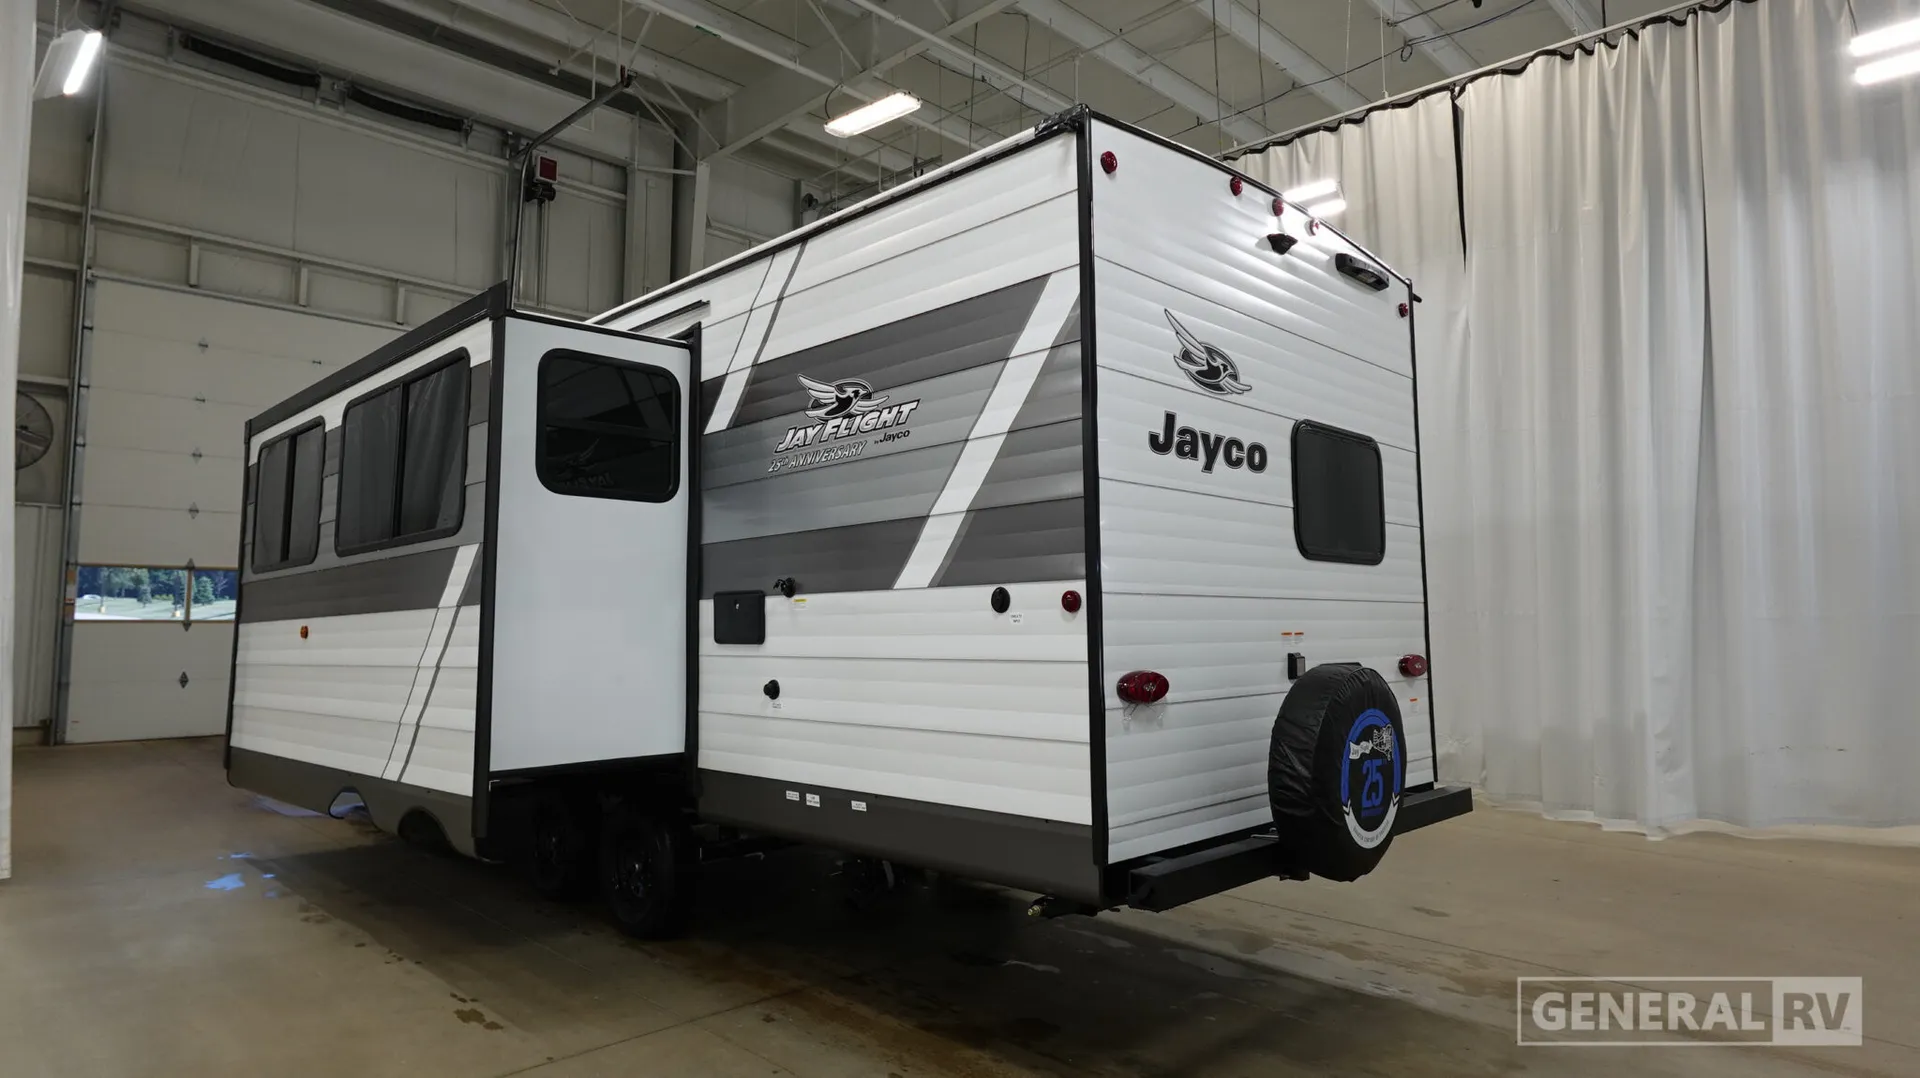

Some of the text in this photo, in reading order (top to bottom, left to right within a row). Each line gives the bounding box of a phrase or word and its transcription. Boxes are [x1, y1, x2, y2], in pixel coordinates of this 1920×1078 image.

[775, 399, 921, 453] JAY FLIGHT
[879, 429, 910, 443] Jayco
[1148, 410, 1268, 474] Jayco
[788, 440, 868, 470] ANNIVERSARY
[1362, 759, 1383, 807] 25
